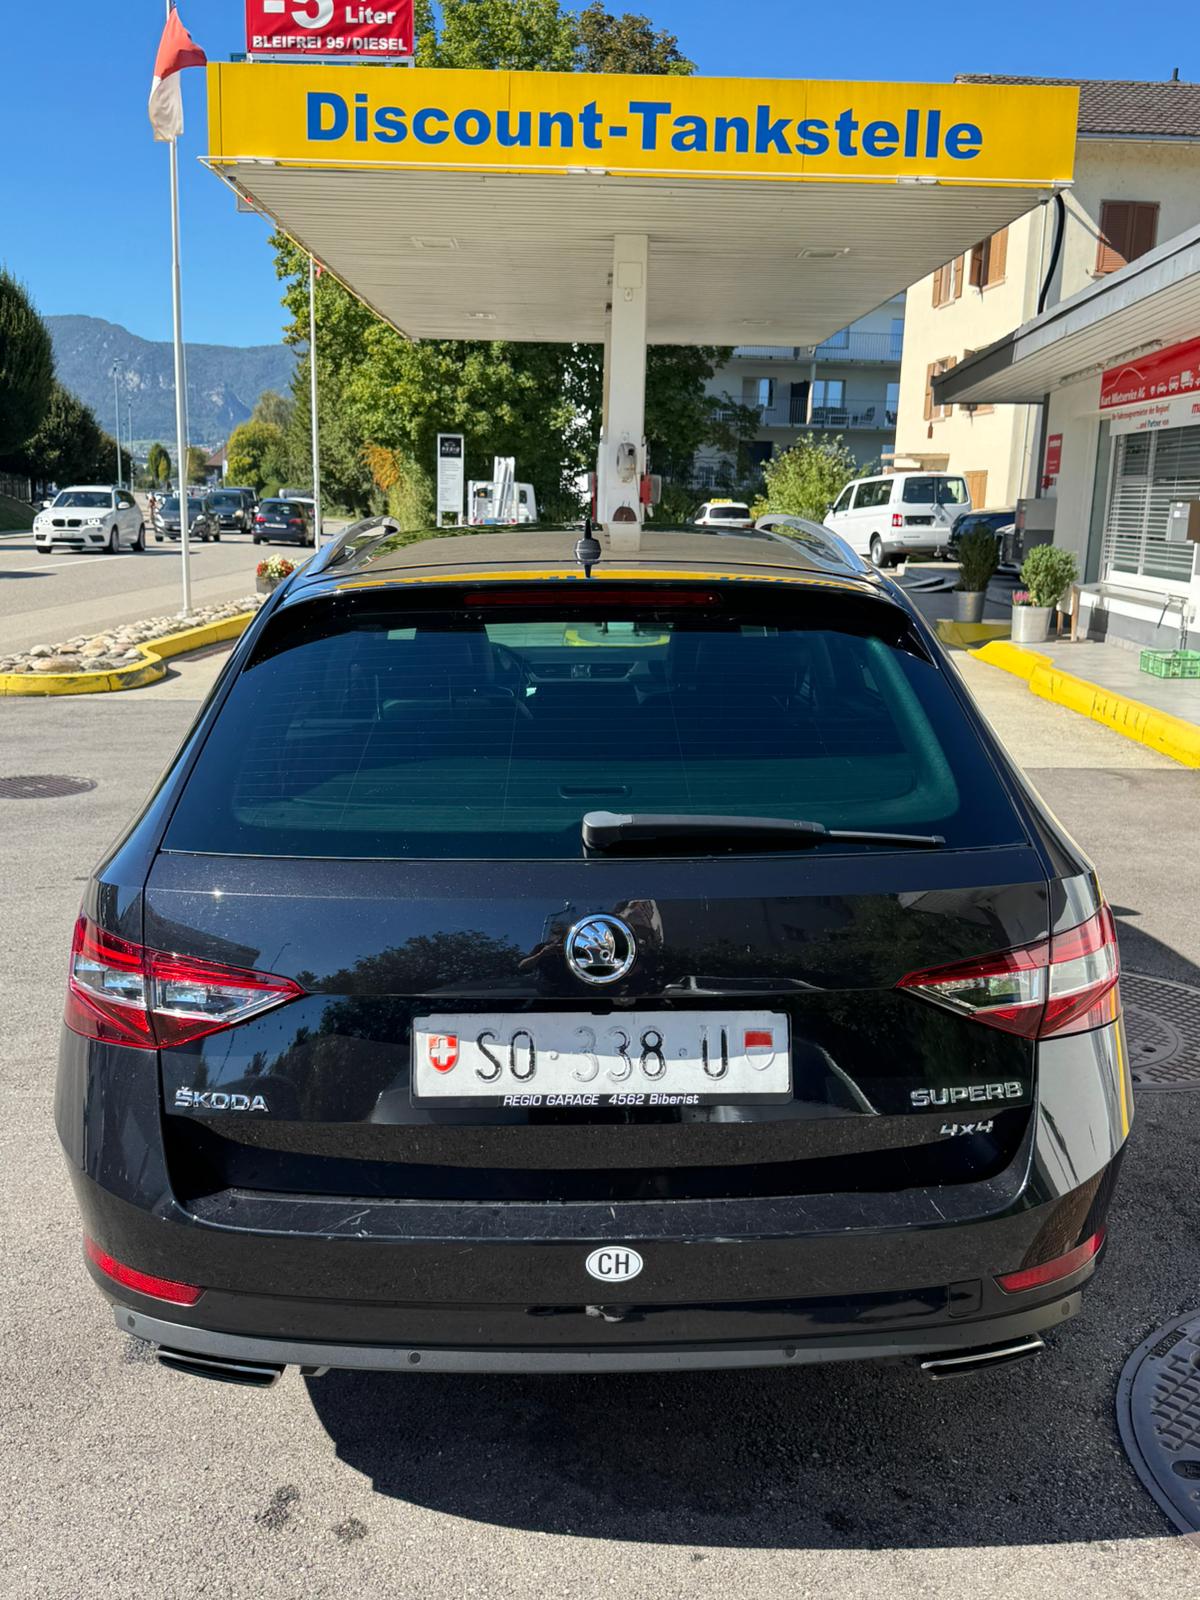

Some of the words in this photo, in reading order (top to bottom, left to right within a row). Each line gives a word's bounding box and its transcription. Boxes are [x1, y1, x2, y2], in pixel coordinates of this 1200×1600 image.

[345, 6, 396, 24] Liter
[252, 35, 322, 49] BLEIFREI
[307, 91, 983, 159] Discount-Tankstelle
[175, 1086, 270, 1112] ŠKODA
[503, 1094, 542, 1107] REGIO
[545, 1094, 600, 1106] GARAGE
[608, 1094, 645, 1105] 4562
[649, 1093, 700, 1105] Biberist
[910, 1081, 1024, 1107] SUPERB
[598, 1253, 630, 1275] CH
